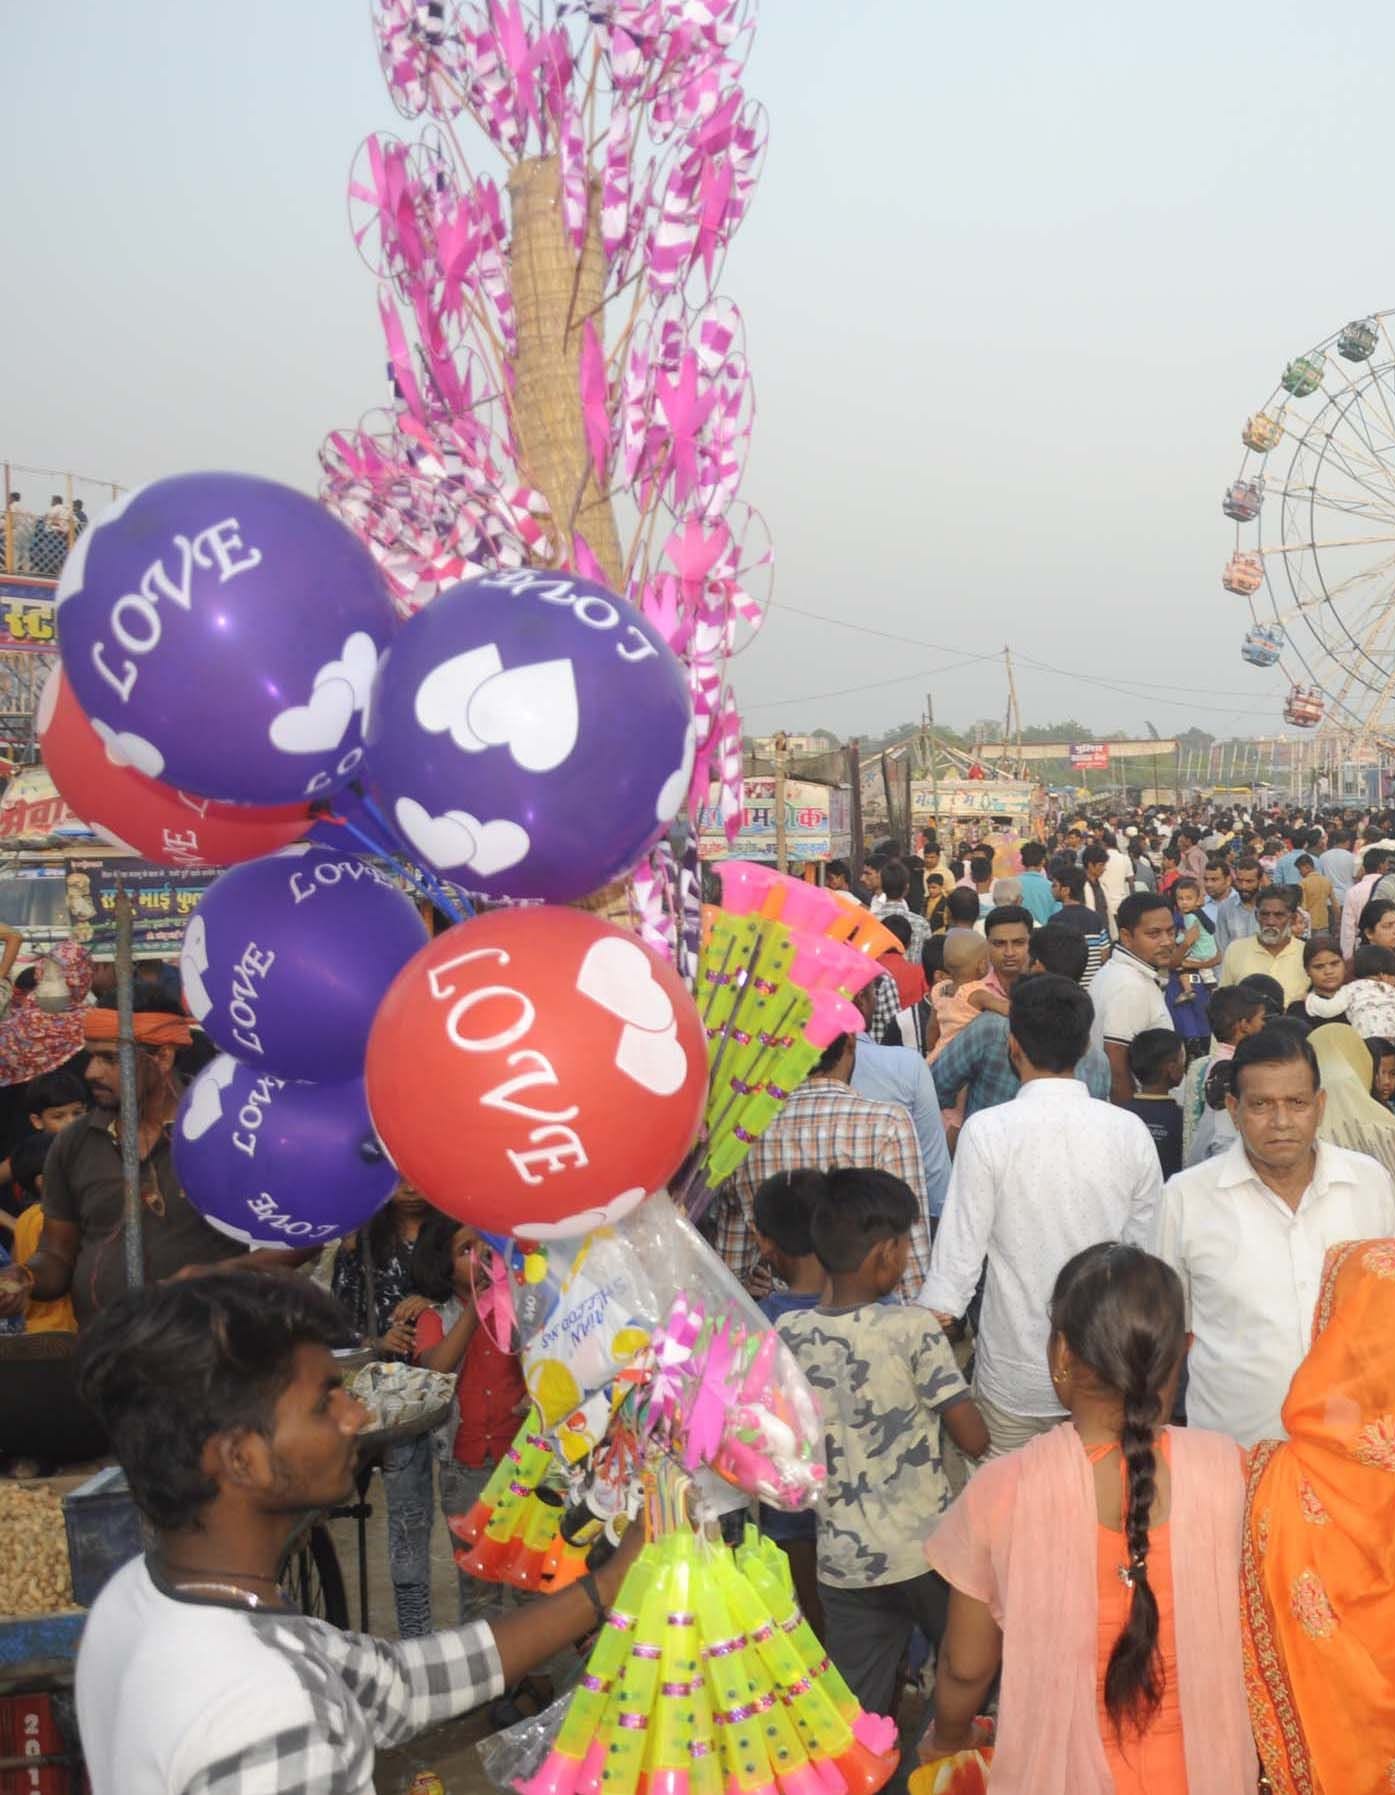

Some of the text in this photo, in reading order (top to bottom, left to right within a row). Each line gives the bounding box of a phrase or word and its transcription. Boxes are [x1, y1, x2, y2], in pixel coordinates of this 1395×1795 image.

[91, 516, 263, 704] LOVE
[303, 747, 363, 794] LO
[229, 941, 276, 1055] LOVE
[428, 947, 590, 1185] LOVE
[246, 1191, 341, 1238] LOVE
